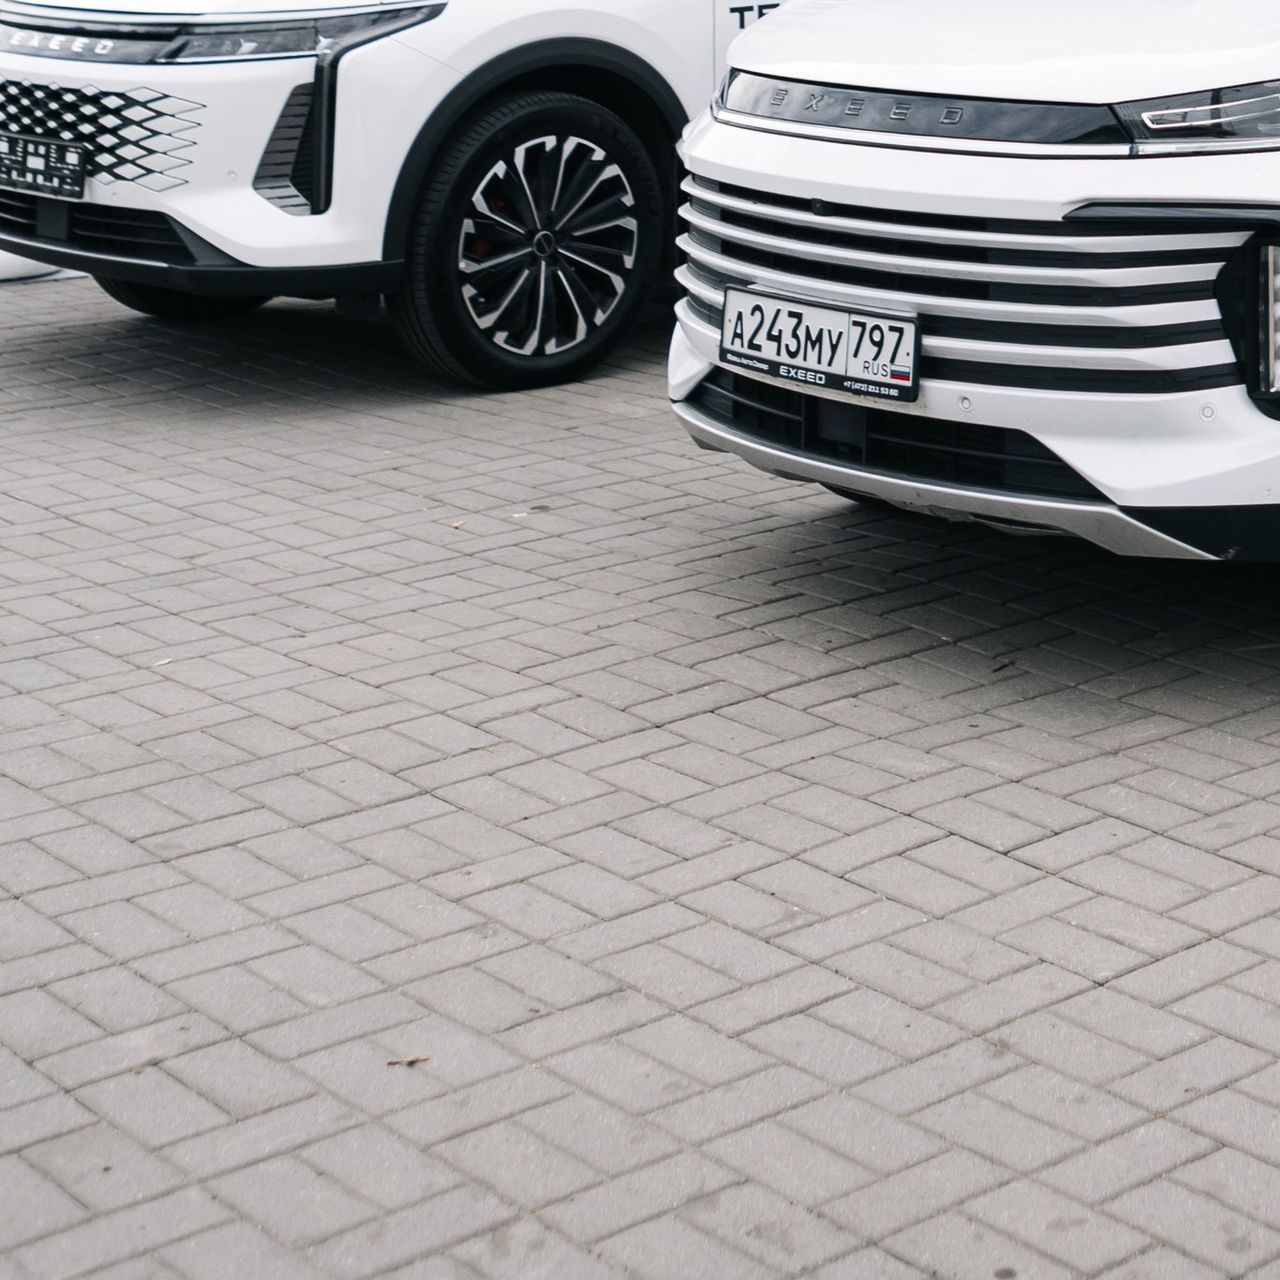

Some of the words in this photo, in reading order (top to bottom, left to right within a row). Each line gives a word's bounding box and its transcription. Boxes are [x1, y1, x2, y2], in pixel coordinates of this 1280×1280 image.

[10, 32, 114, 55] EXEED
[770, 89, 964, 126] EXEED
[779, 365, 826, 385] EXEED
[862, 361, 889, 378] RUS
